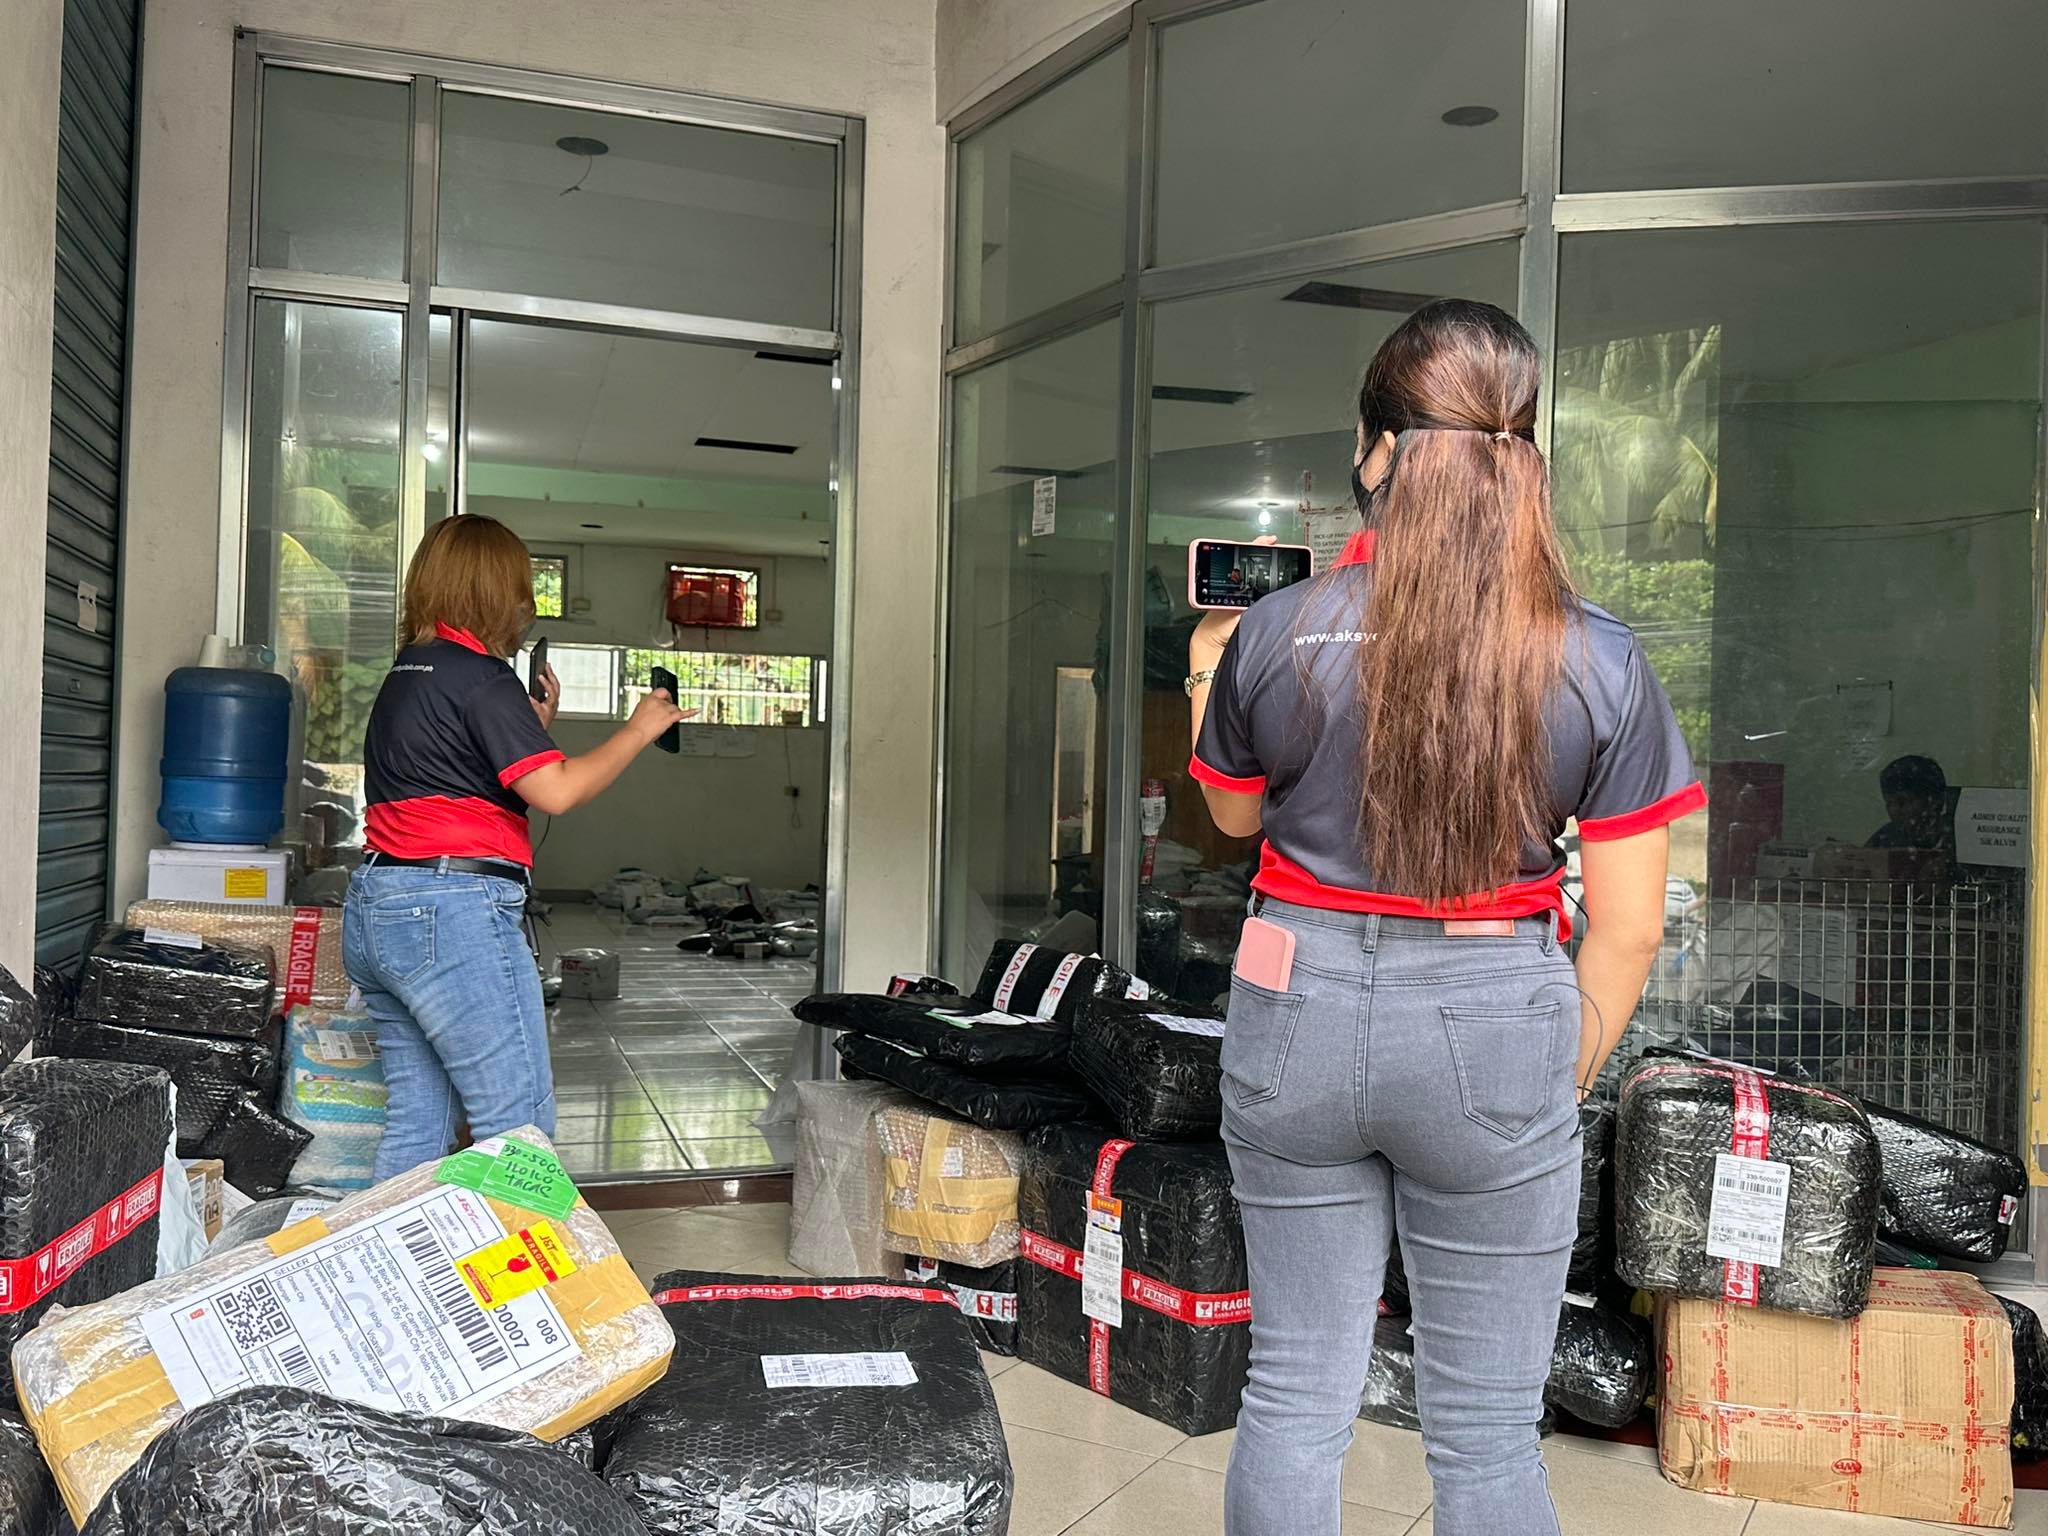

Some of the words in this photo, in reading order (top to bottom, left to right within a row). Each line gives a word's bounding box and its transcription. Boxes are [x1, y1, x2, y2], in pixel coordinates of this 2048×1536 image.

[288, 931, 316, 993] FRAGILE
[994, 944, 1035, 1010] FRAGILE
[1048, 952, 1081, 998] AGILE
[127, 1189, 155, 1215] FRAGILE
[59, 1232, 92, 1265] FRAGILE
[332, 1234, 364, 1251] BUYER
[523, 1236, 552, 1273] FRAGILE
[1033, 1244, 1064, 1263] FRAGILE
[274, 1257, 310, 1276] SELLER
[323, 1259, 340, 1279] Tacas
[1144, 1287, 1179, 1308] FRAGILE
[1213, 1297, 1252, 1312] FRAGIL
[377, 1267, 393, 1286] Block
[423, 1345, 449, 1379] Ledesma
[491, 1302, 531, 1351] 00007
[533, 1317, 559, 1345] 008
[341, 1269, 356, 1284] City
[413, 1389, 434, 1415] HOME
